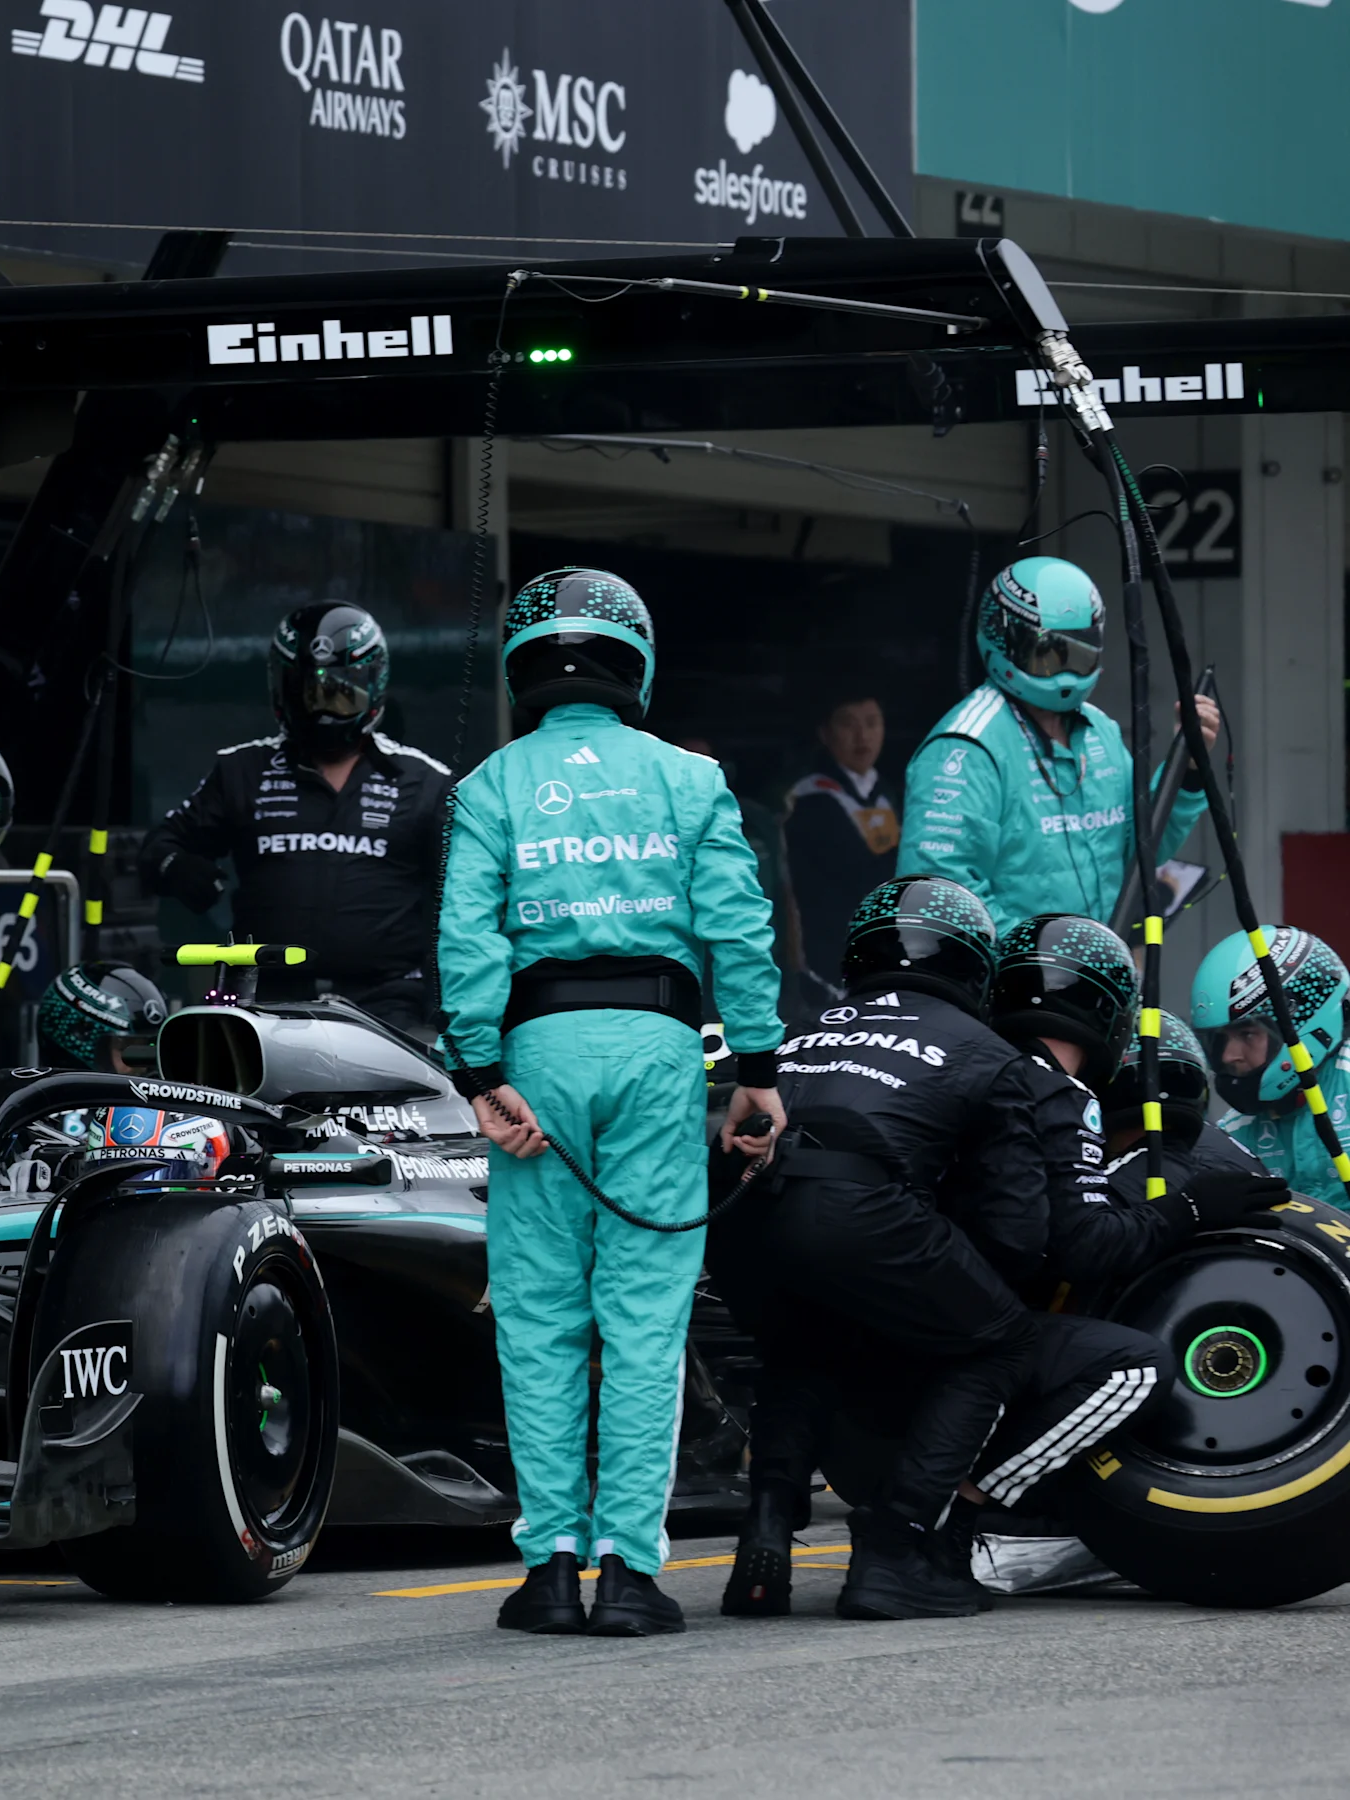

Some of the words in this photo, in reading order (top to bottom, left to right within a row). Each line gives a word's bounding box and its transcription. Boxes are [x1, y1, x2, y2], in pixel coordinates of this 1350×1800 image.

[36, 0, 184, 79] DHL
[281, 12, 404, 92] QATAR
[310, 89, 407, 139] AIRWAYS
[532, 69, 627, 153] MSC
[532, 155, 627, 190] CRUISES
[694, 158, 807, 225] salesforce
[207, 315, 453, 364] Einhell
[1016, 363, 1244, 406] Enhell
[1156, 489, 1235, 562] 22
[257, 832, 389, 858] PETRONAS
[516, 833, 681, 870] ETRONAS
[547, 895, 677, 921] TeamViewer
[777, 1060, 907, 1090] TeamViewer
[138, 1082, 242, 1111] CROWDSTRIKE
[170, 1121, 214, 1140] CROWDSTRIKE
[100, 1148, 165, 1159] PETRONAS
[284, 1162, 352, 1174] PETRONAS
[1269, 1200, 1315, 1214] P
[233, 1244, 246, 1285] P
[60, 1345, 129, 1399] IWC
